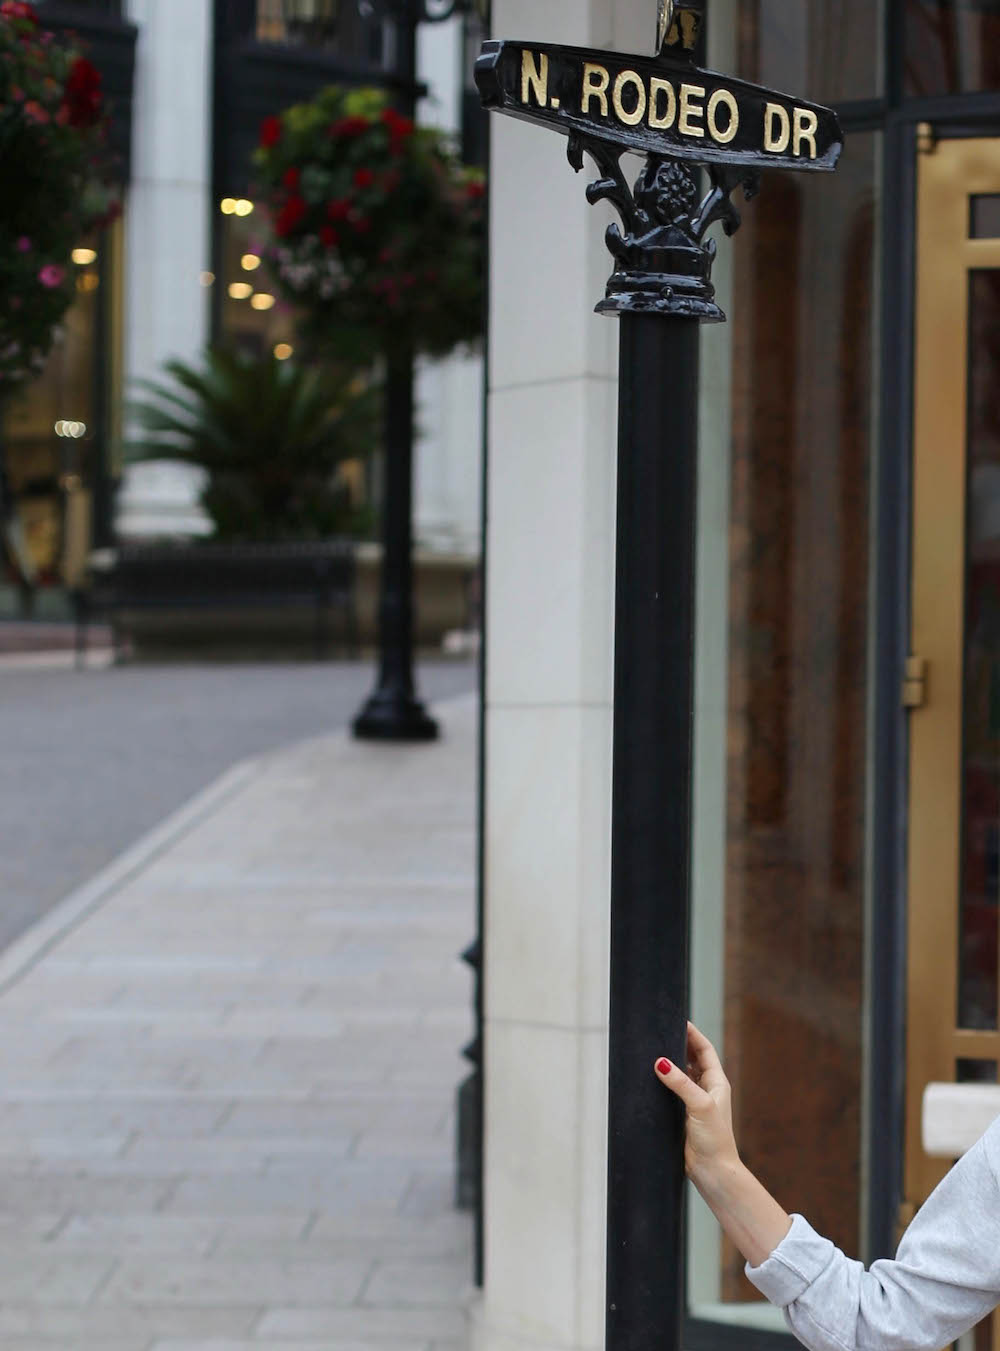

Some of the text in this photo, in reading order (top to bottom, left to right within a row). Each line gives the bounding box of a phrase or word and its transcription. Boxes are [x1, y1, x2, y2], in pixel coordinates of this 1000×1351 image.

[521, 50, 817, 159] N. RODEO DR
